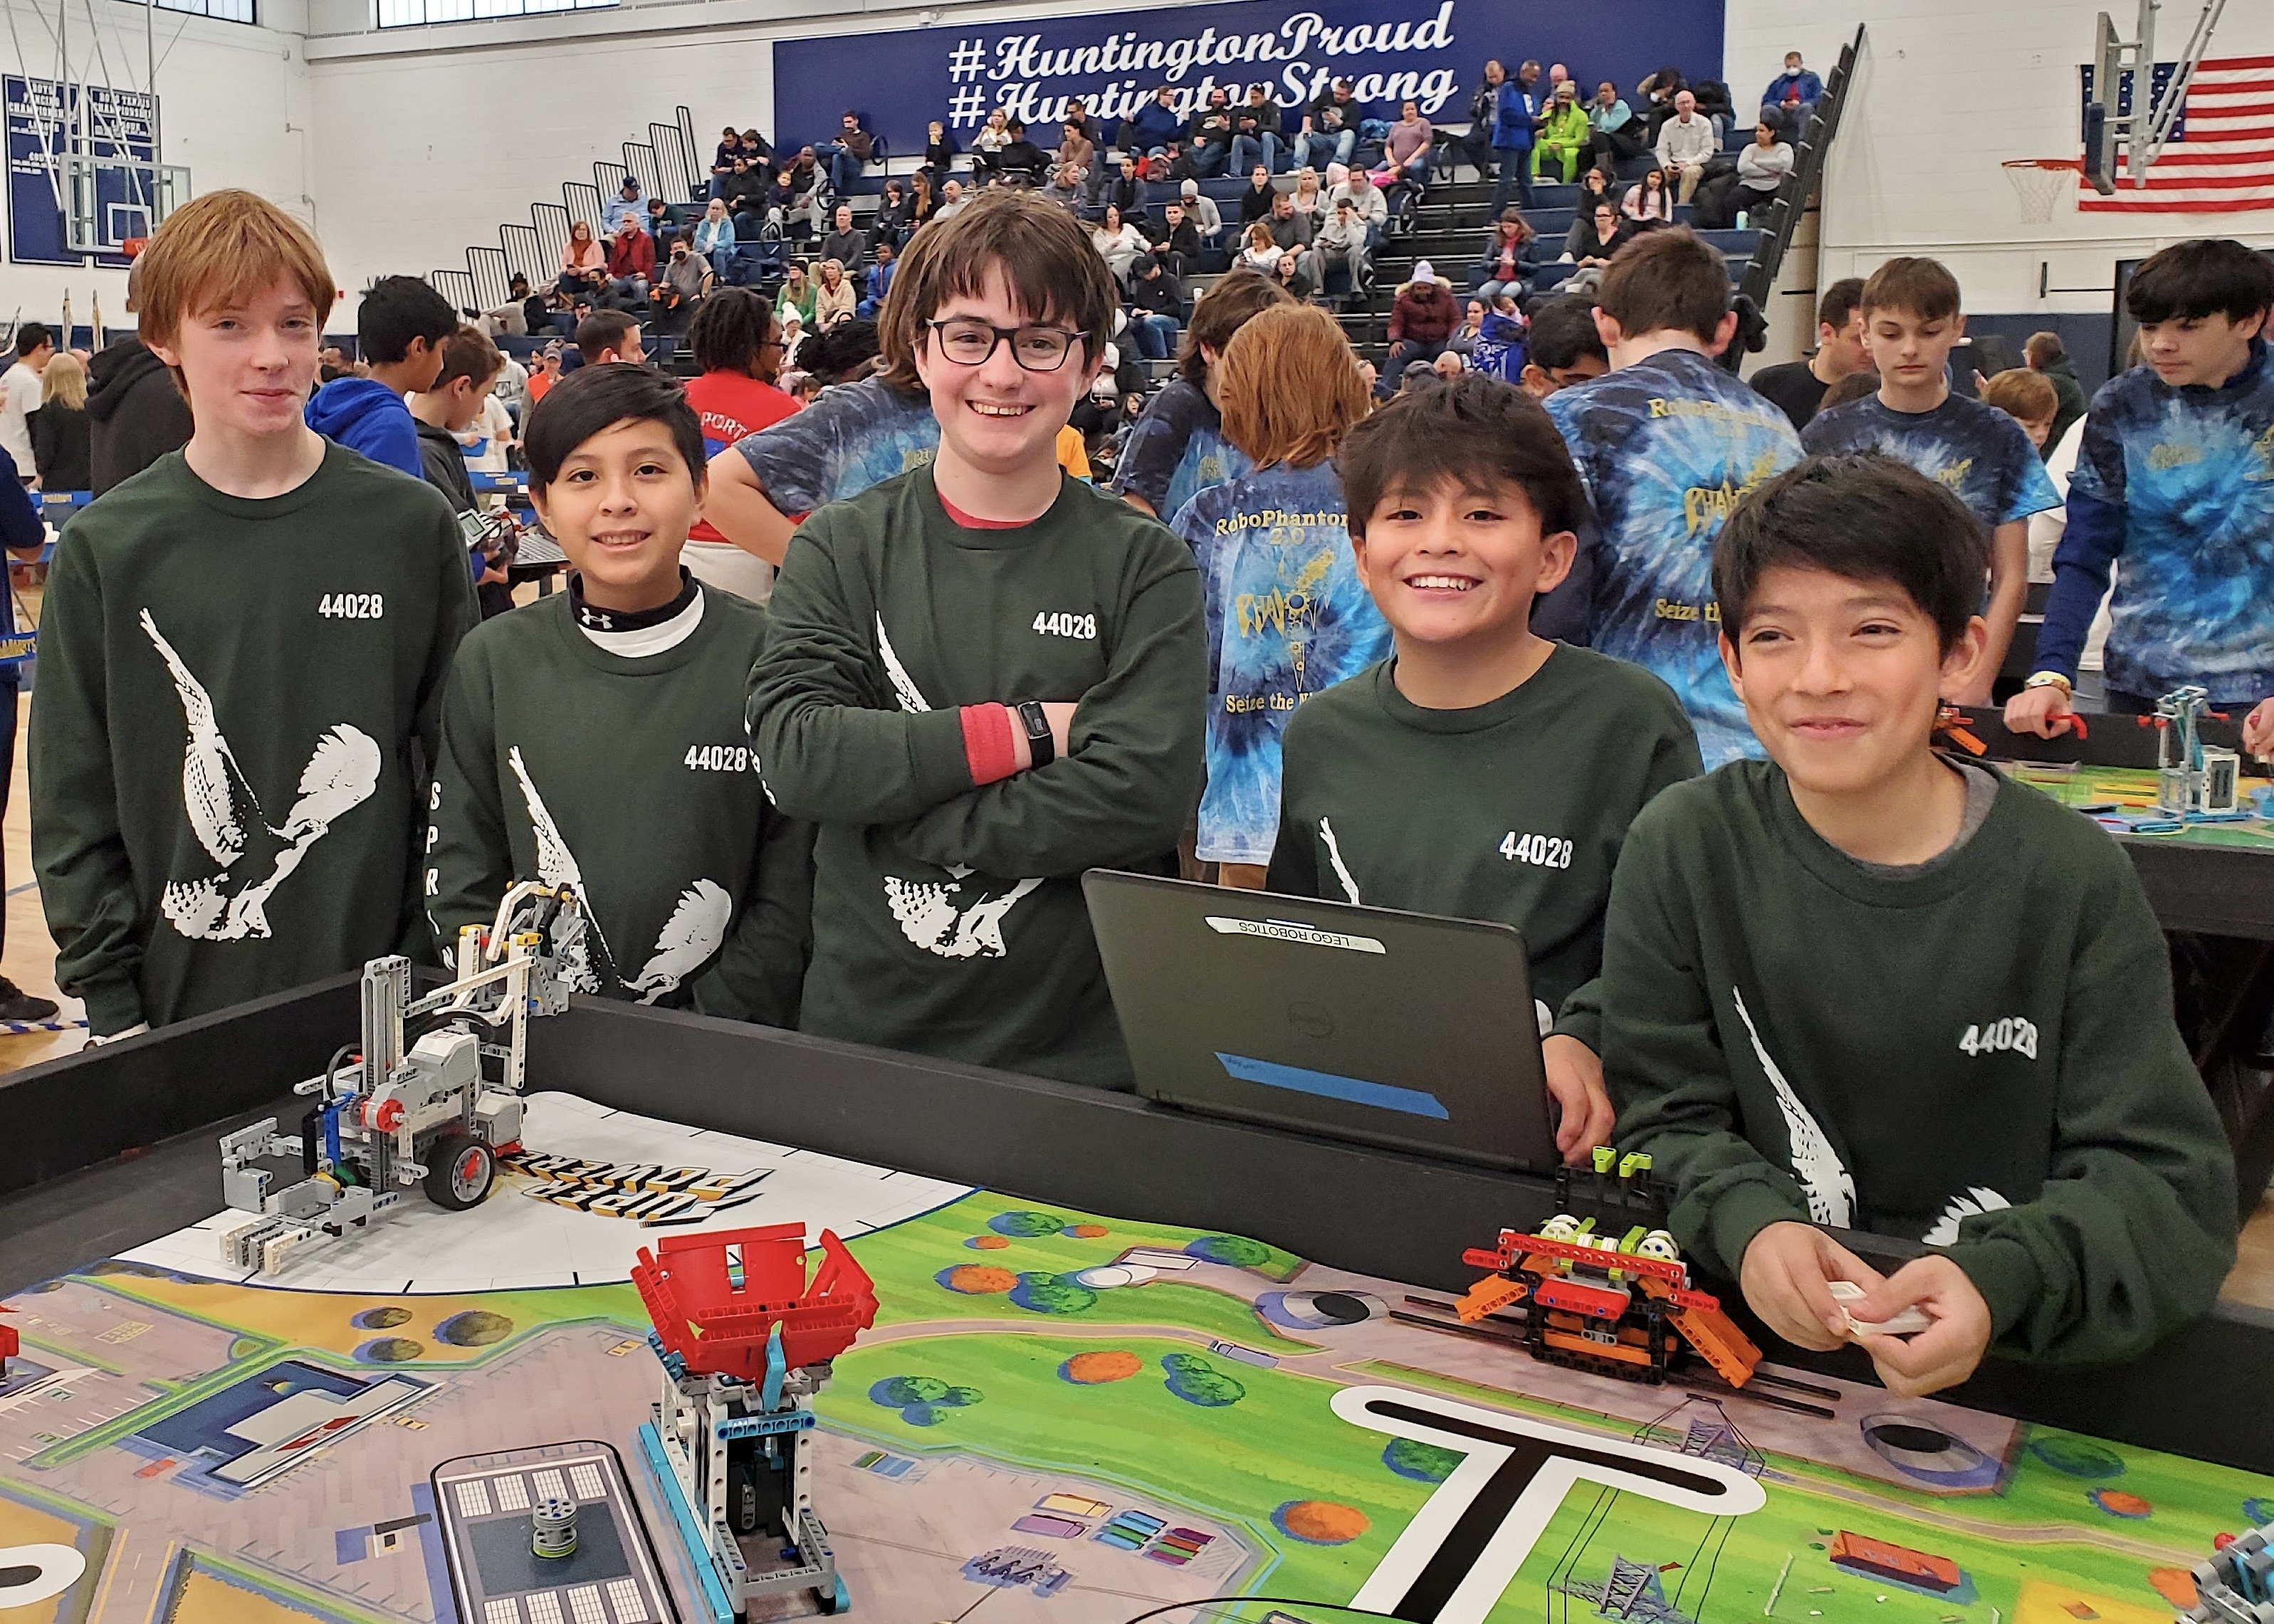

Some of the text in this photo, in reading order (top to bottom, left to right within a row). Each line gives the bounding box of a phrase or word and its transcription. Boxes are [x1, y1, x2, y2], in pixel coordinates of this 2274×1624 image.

[948, 1, 1455, 83] #HuntingtonProud
[318, 593, 383, 619] 44028
[1654, 598, 1699, 622] Seize
[1032, 612, 1096, 639] 44028
[1225, 694, 1264, 713] Seize
[1269, 691, 1294, 711] the
[684, 745, 748, 772] 44028
[1499, 831, 1573, 869] 44028
[1239, 922, 1349, 946] LEGO ROBOTICS
[1959, 1017, 2038, 1059] 44028
[501, 1150, 777, 1201] POWERE
